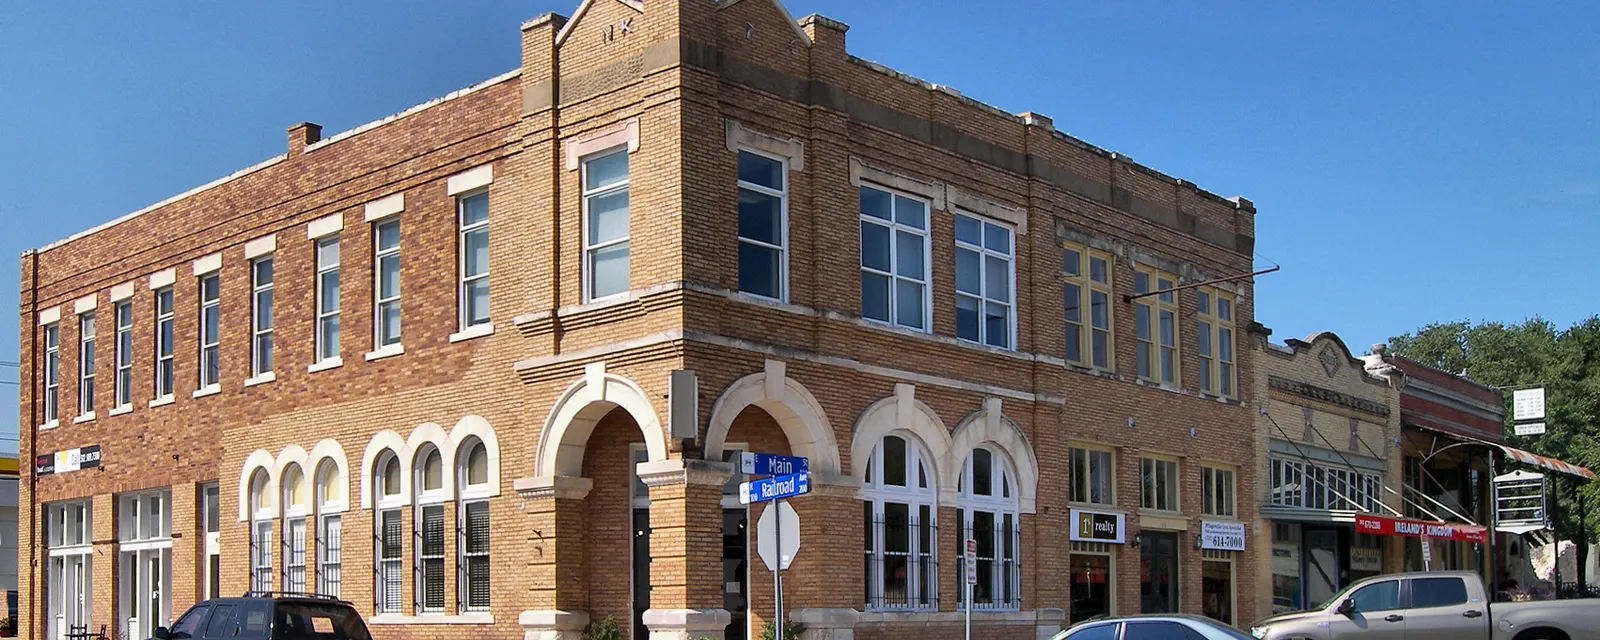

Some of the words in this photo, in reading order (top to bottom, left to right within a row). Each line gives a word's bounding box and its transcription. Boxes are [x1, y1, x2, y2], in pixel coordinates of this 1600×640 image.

[768, 457, 792, 474] Main
[761, 477, 795, 498] Railroad
[799, 473, 808, 482] Ave
[799, 484, 808, 493] 200
[1095, 520, 1115, 534] realty
[1395, 521, 1424, 535] IRELAND'S
[1427, 524, 1453, 537] KINGDOM
[1213, 536, 1242, 548] 614-7000
